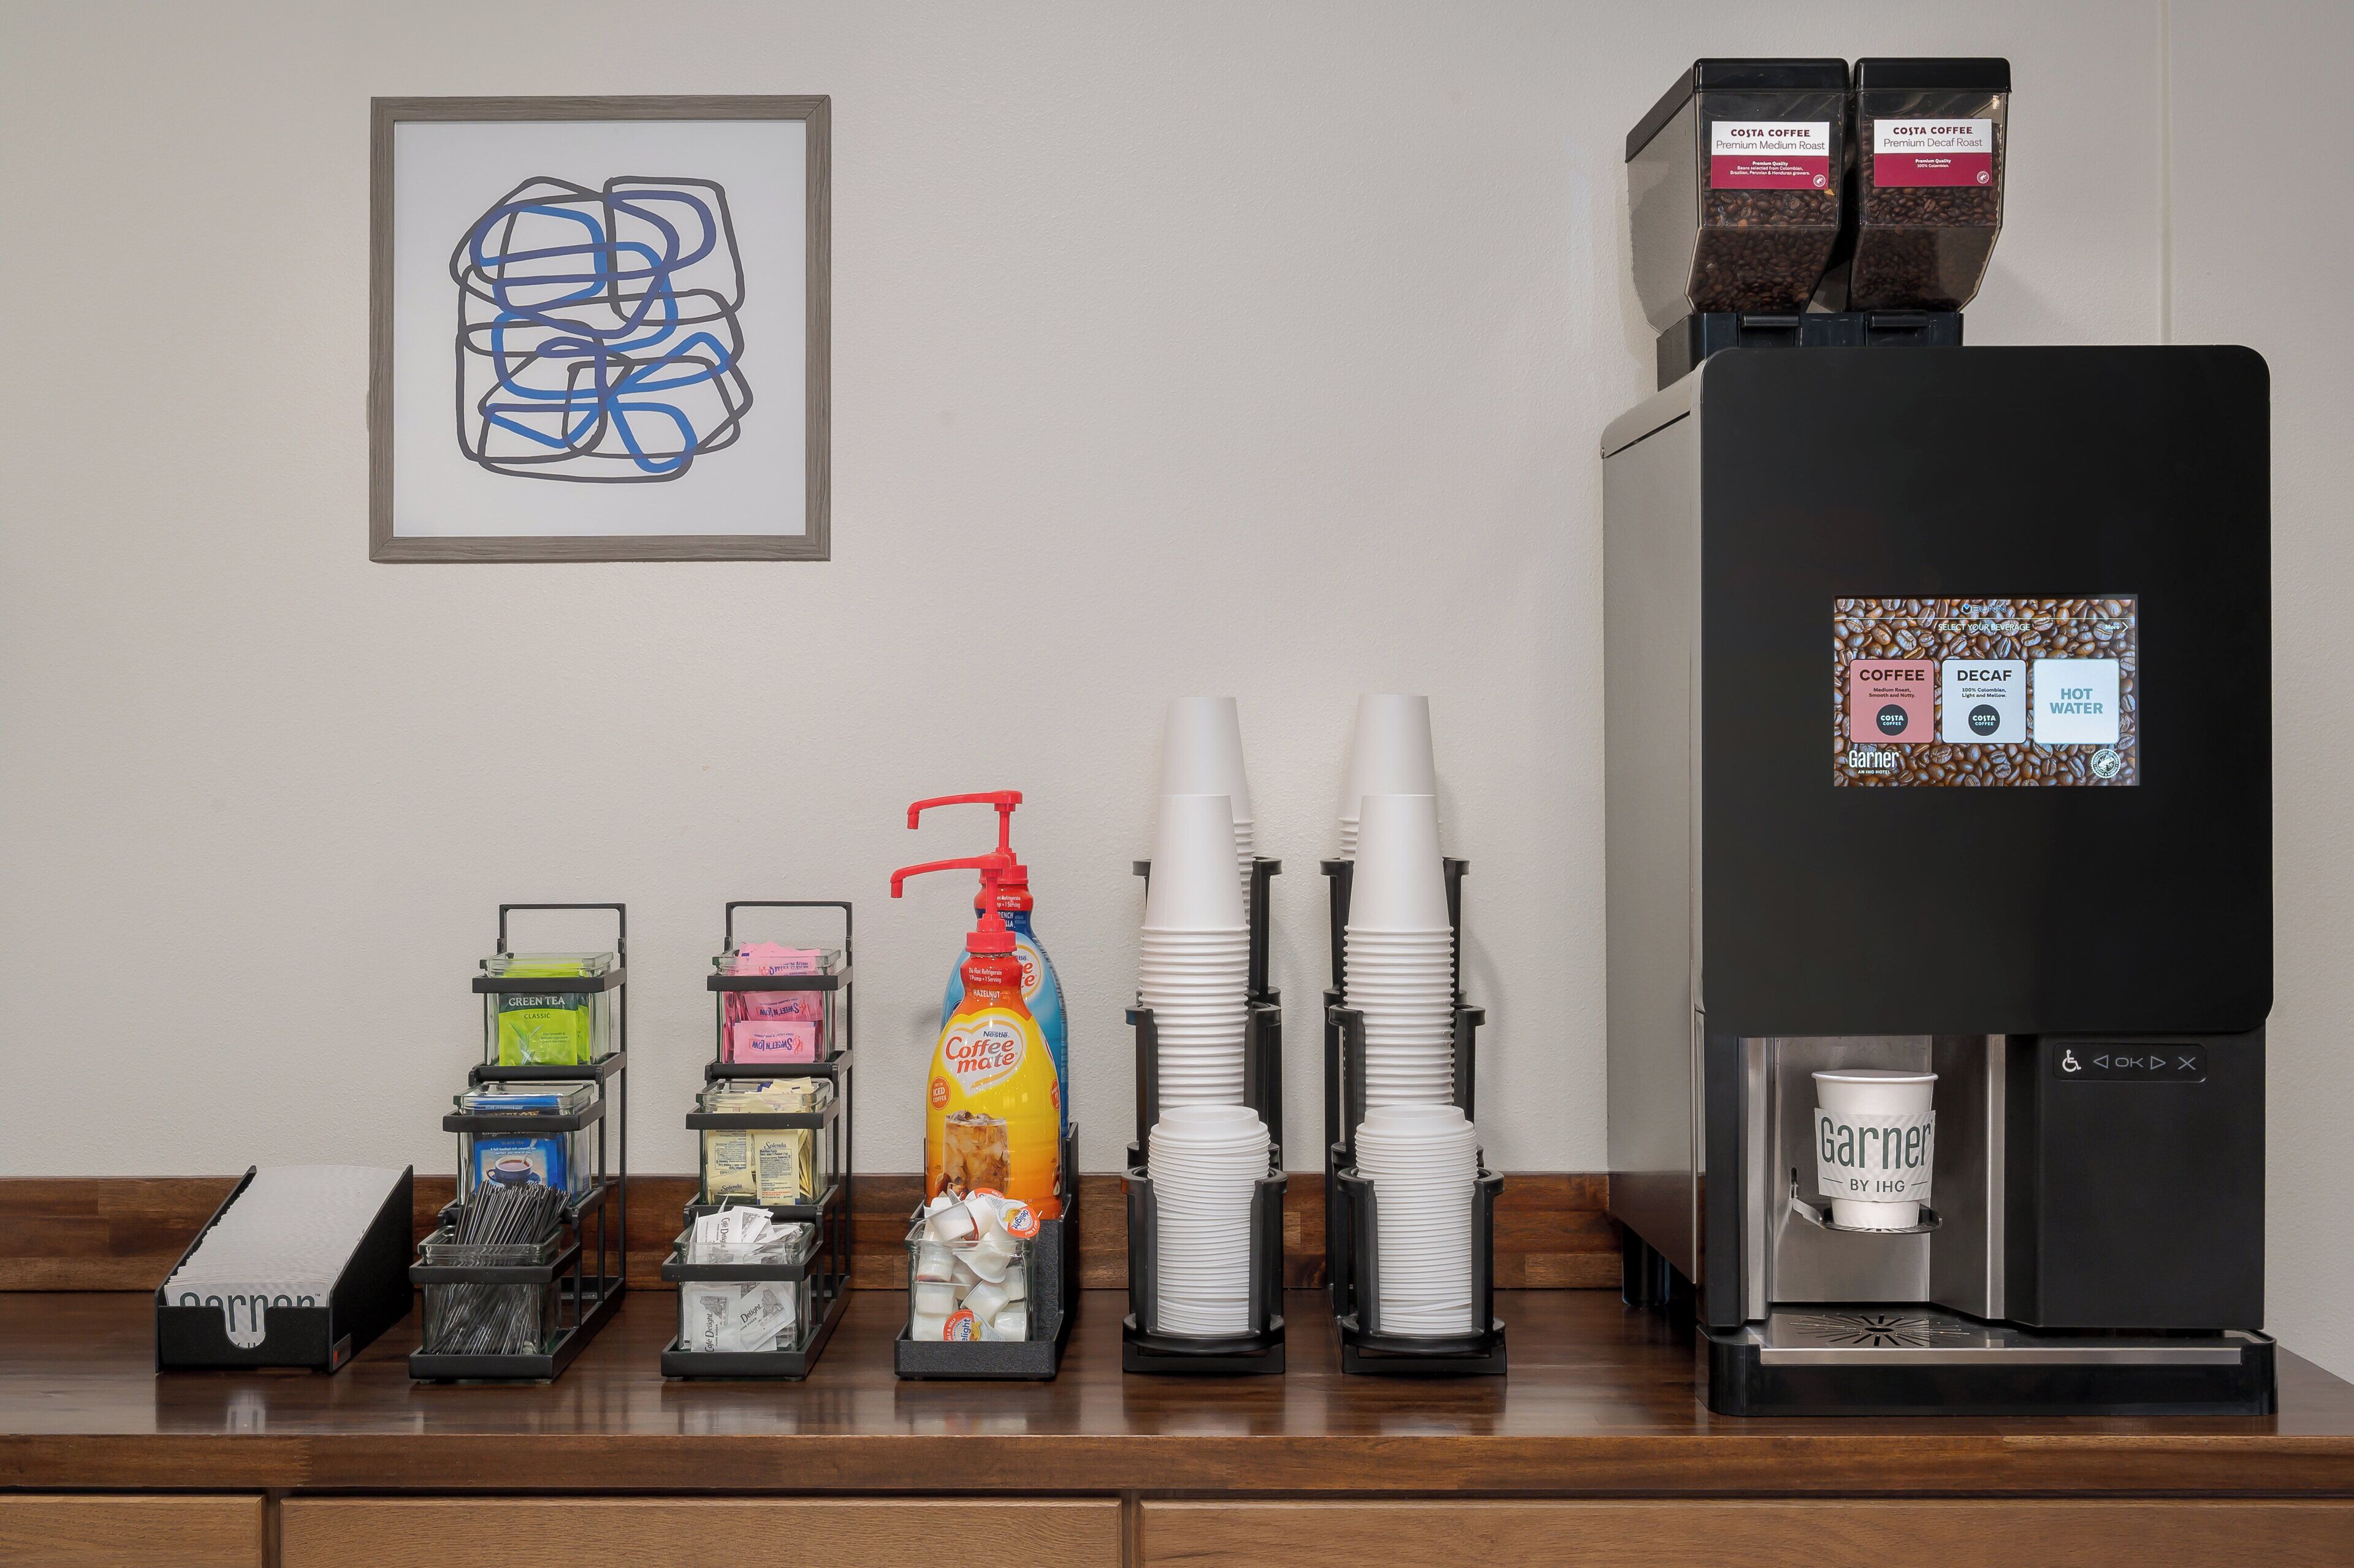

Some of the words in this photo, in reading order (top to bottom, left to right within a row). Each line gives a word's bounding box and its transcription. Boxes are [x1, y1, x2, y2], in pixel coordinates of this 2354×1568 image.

[1731, 129, 1764, 137] COSTA
[1893, 127, 1926, 135] COSTA
[1716, 140, 1757, 150] Premium
[1759, 141, 1796, 150] Medium
[1799, 141, 1825, 150] Roast
[1884, 139, 1925, 147] Premium
[1927, 138, 1955, 147] Decaf
[1957, 138, 1983, 147] Roast
[1859, 669, 1925, 681] COFFEE
[1957, 670, 2012, 682] DECAF
[2060, 688, 2093, 700] HOT
[2049, 702, 2103, 714] WATER
[1849, 750, 1899, 768] Garner
[973, 989, 1000, 999] HAZELNUT
[508, 997, 543, 1007] GREEN
[544, 996, 566, 1005] TEA
[945, 1037, 1015, 1060] Coffee
[957, 1052, 1015, 1073] mate
[2115, 1057, 2144, 1068] OK
[933, 1087, 945, 1097] ICED
[764, 1141, 787, 1150] Splenda
[1821, 1116, 1931, 1170] Garner
[720, 1183, 742, 1192] Splenda
[1850, 1178, 1869, 1192] BY
[1876, 1180, 1905, 1193] IHG
[1011, 1209, 1029, 1230] delight
[740, 1303, 762, 1323] Delight
[705, 1312, 714, 1338] Delight
[960, 1319, 971, 1341] elight
[704, 1339, 714, 1352] Café
